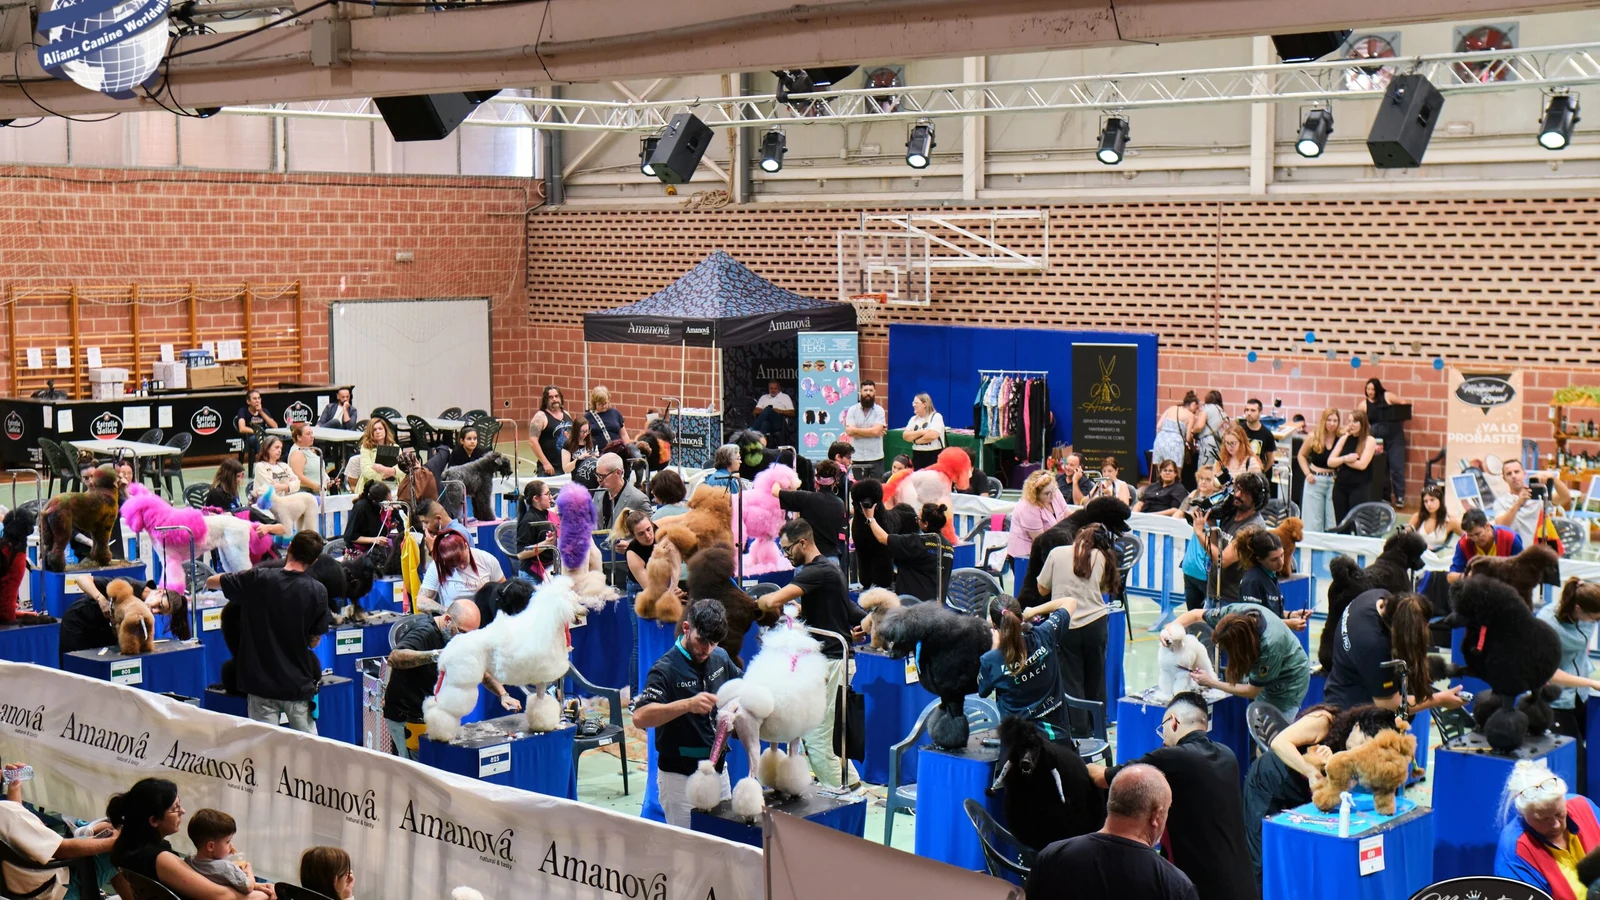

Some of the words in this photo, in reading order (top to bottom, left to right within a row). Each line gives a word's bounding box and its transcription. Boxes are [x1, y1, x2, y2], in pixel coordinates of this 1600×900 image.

[801, 344, 826, 353] TEKH
[1501, 423, 1519, 434] LO
[1014, 662, 1047, 685] COACH
[676, 680, 697, 688] COACH
[345, 816, 360, 825] natural
[479, 855, 496, 865] natural
